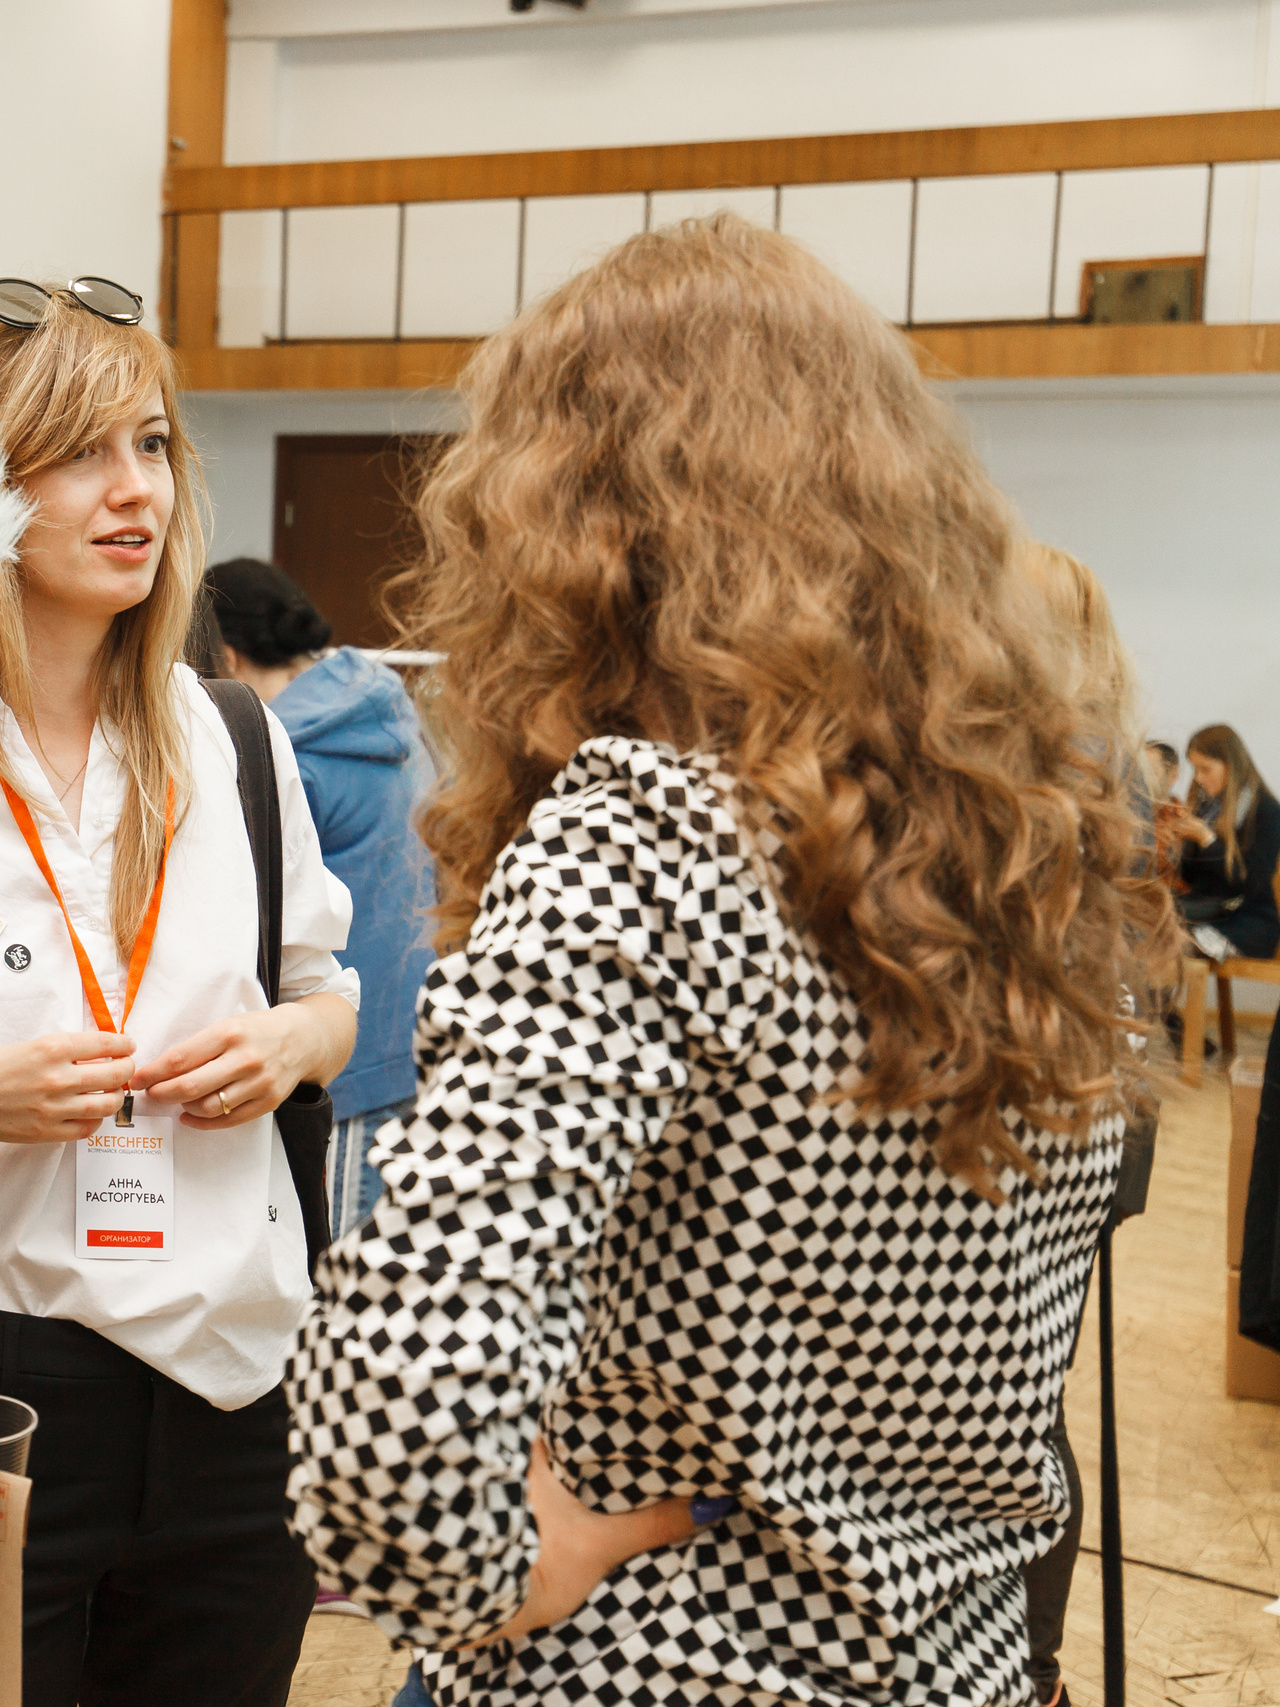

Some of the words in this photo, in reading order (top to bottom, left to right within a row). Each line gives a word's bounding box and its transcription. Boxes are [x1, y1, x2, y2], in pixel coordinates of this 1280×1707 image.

[87, 1135, 164, 1149] SKETCHFEST
[108, 1178, 143, 1189] АННА
[86, 1191, 165, 1204] РАСТОРГУЕВА
[99, 1234, 152, 1244] ОРГАНИЗАТОР
